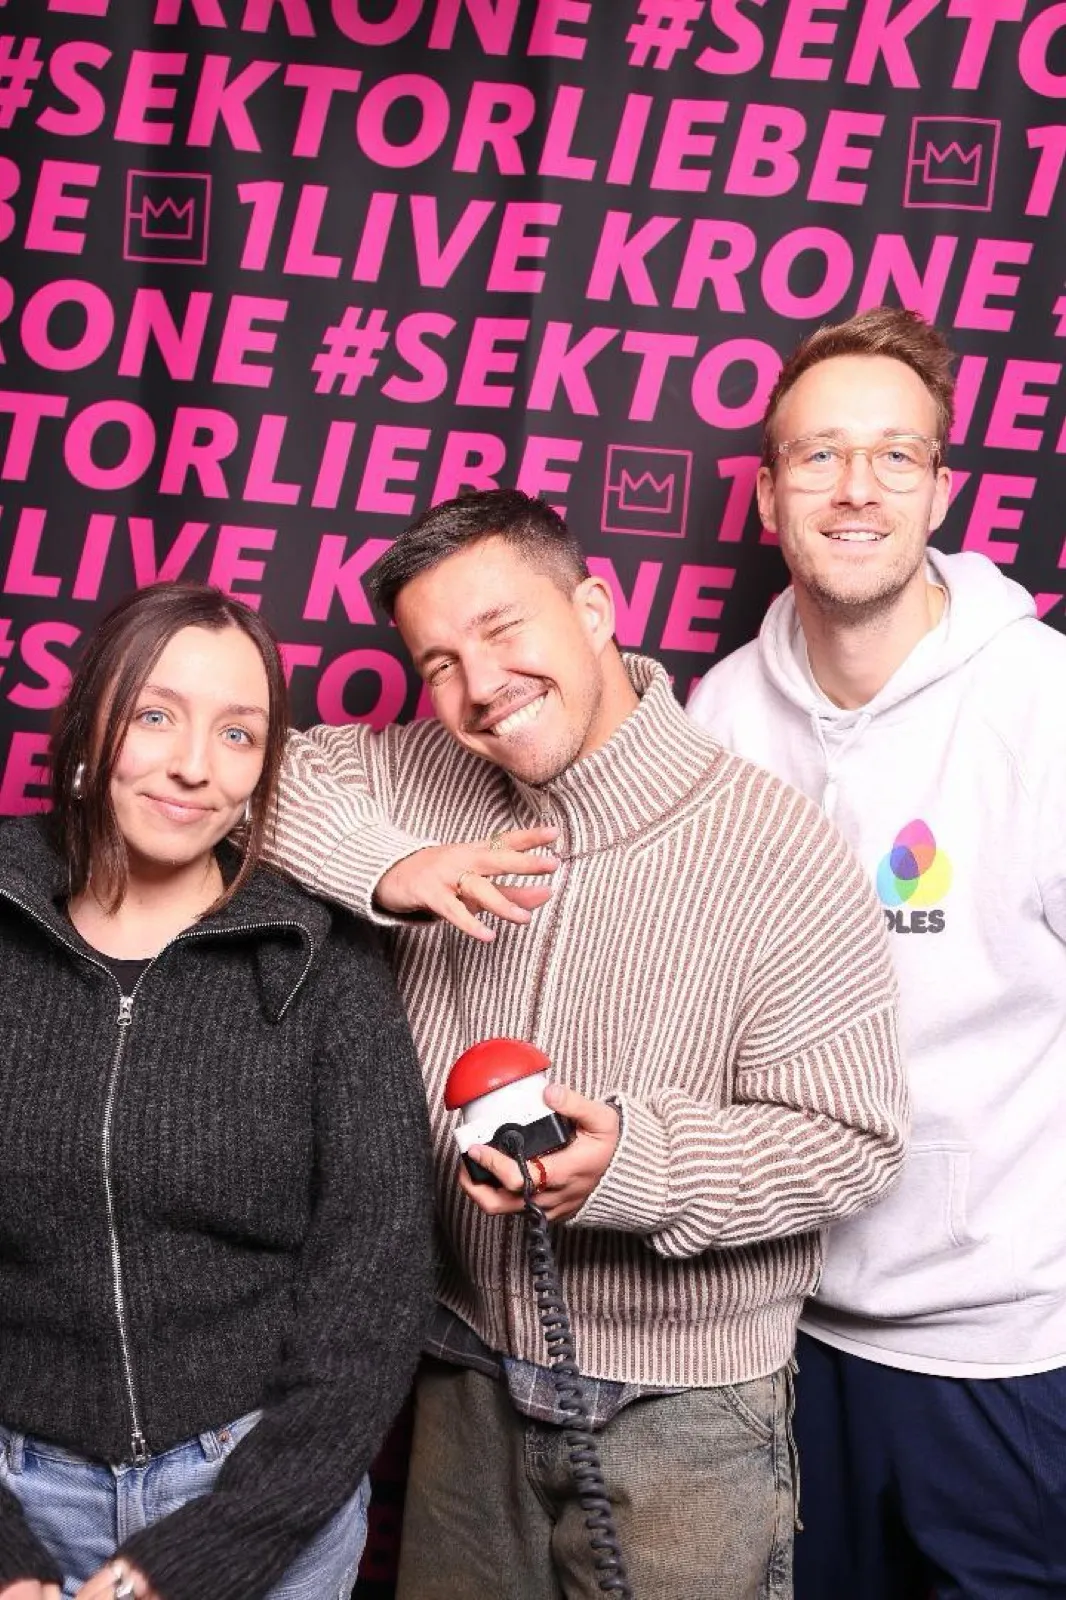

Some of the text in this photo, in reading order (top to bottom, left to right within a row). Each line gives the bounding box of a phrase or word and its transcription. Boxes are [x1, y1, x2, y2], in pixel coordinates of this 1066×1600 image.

[0, 35, 886, 206] #SEKTORLIEBE
[0, 156, 1034, 332] E 1LIVE KRONE
[0, 277, 289, 388] ONE
